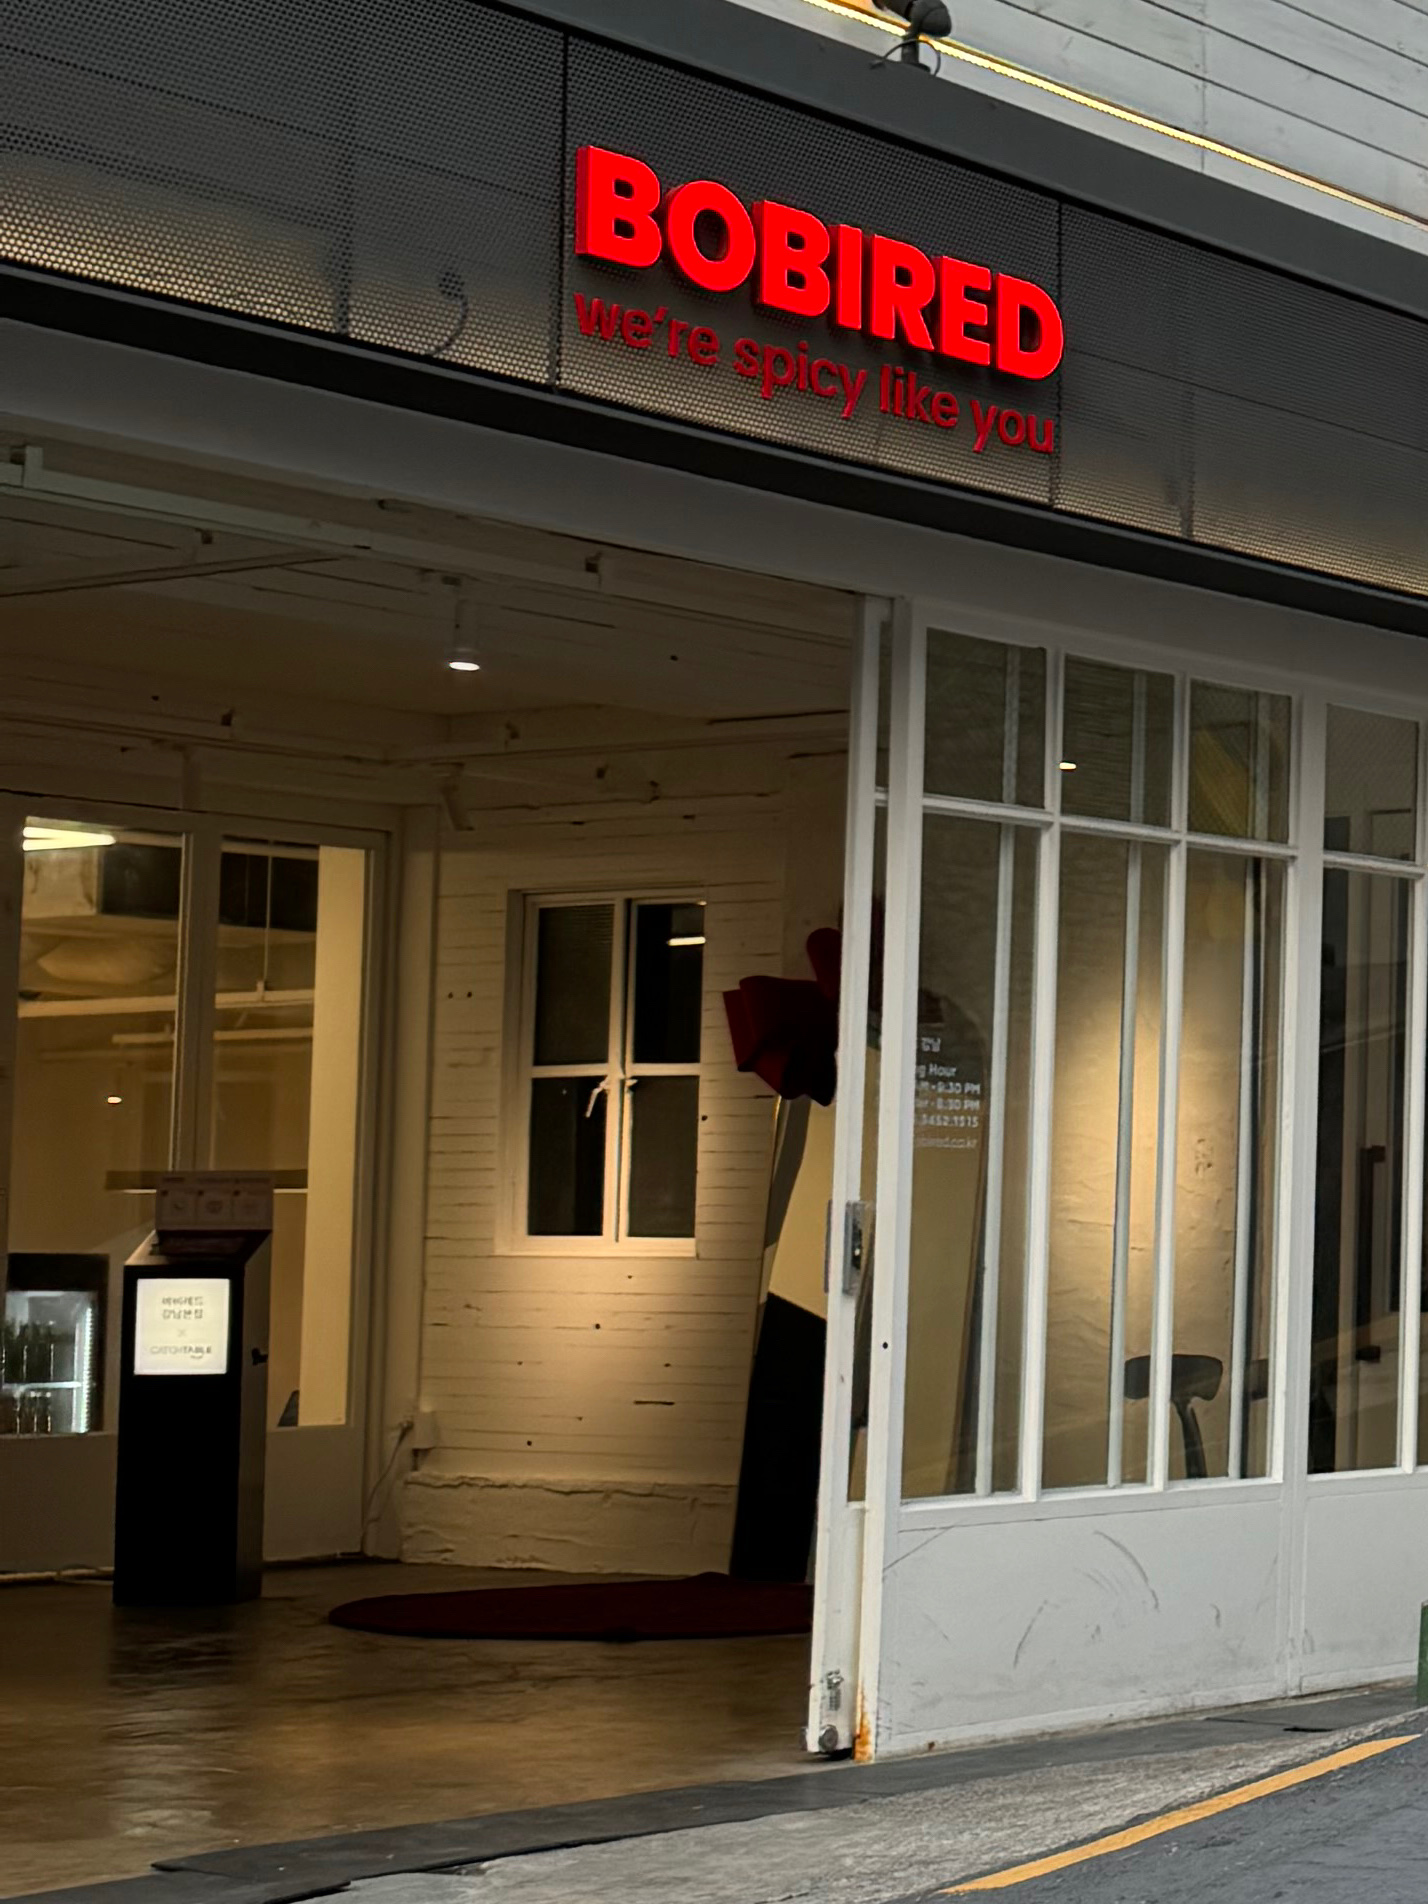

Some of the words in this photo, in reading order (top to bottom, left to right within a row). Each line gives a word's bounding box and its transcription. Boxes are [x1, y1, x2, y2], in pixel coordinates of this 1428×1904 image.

[575, 144, 1064, 380] BOBIRED
[734, 336, 867, 419] spicy
[880, 365, 959, 428] like
[971, 399, 1057, 454] you
[929, 1063, 957, 1077] Hour
[964, 1082, 981, 1095] PM
[963, 1099, 981, 1111] PM
